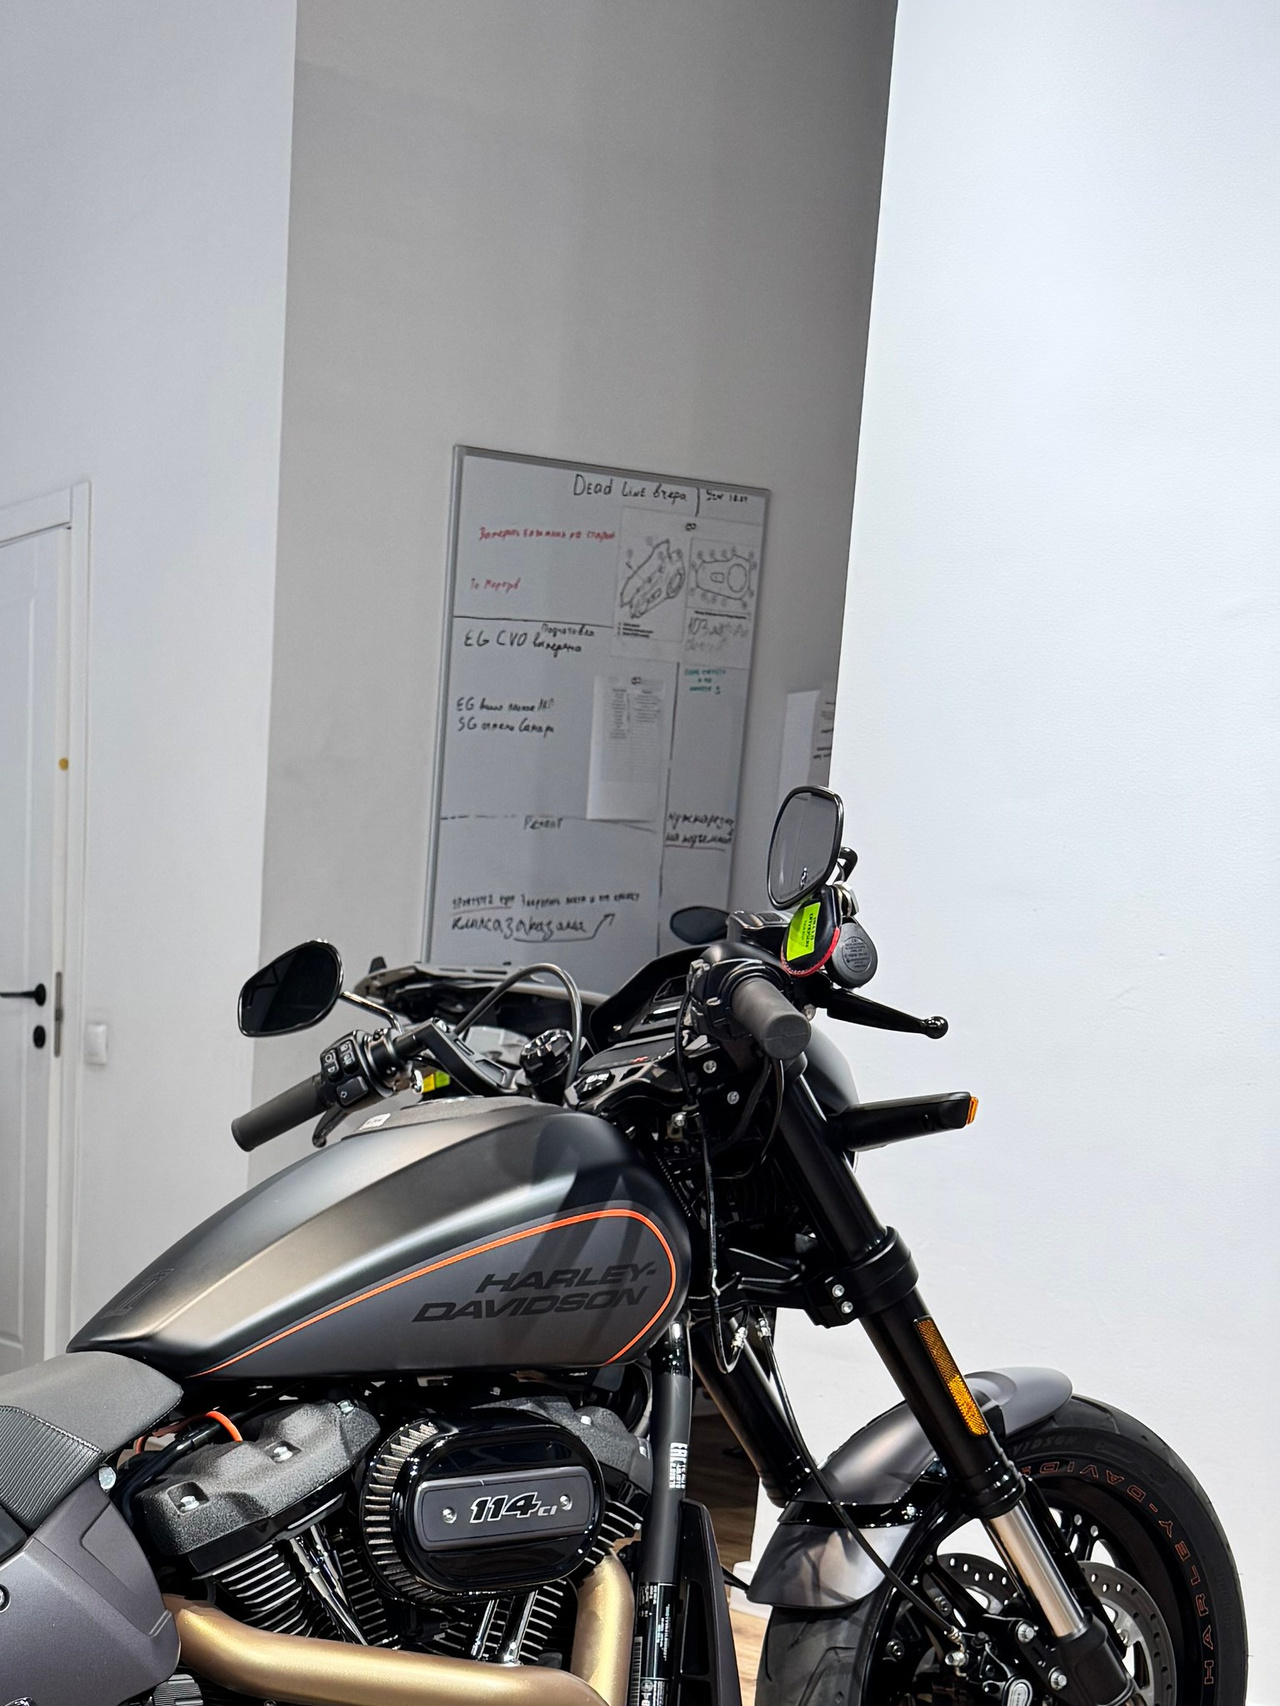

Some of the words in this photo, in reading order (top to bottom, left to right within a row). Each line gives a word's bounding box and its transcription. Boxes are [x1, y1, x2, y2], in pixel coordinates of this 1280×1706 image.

[496, 629, 528, 647] CVO
[411, 1285, 649, 1323] DAVIDSON
[1019, 1460, 1216, 1686] HARLEY-DAVIDS
